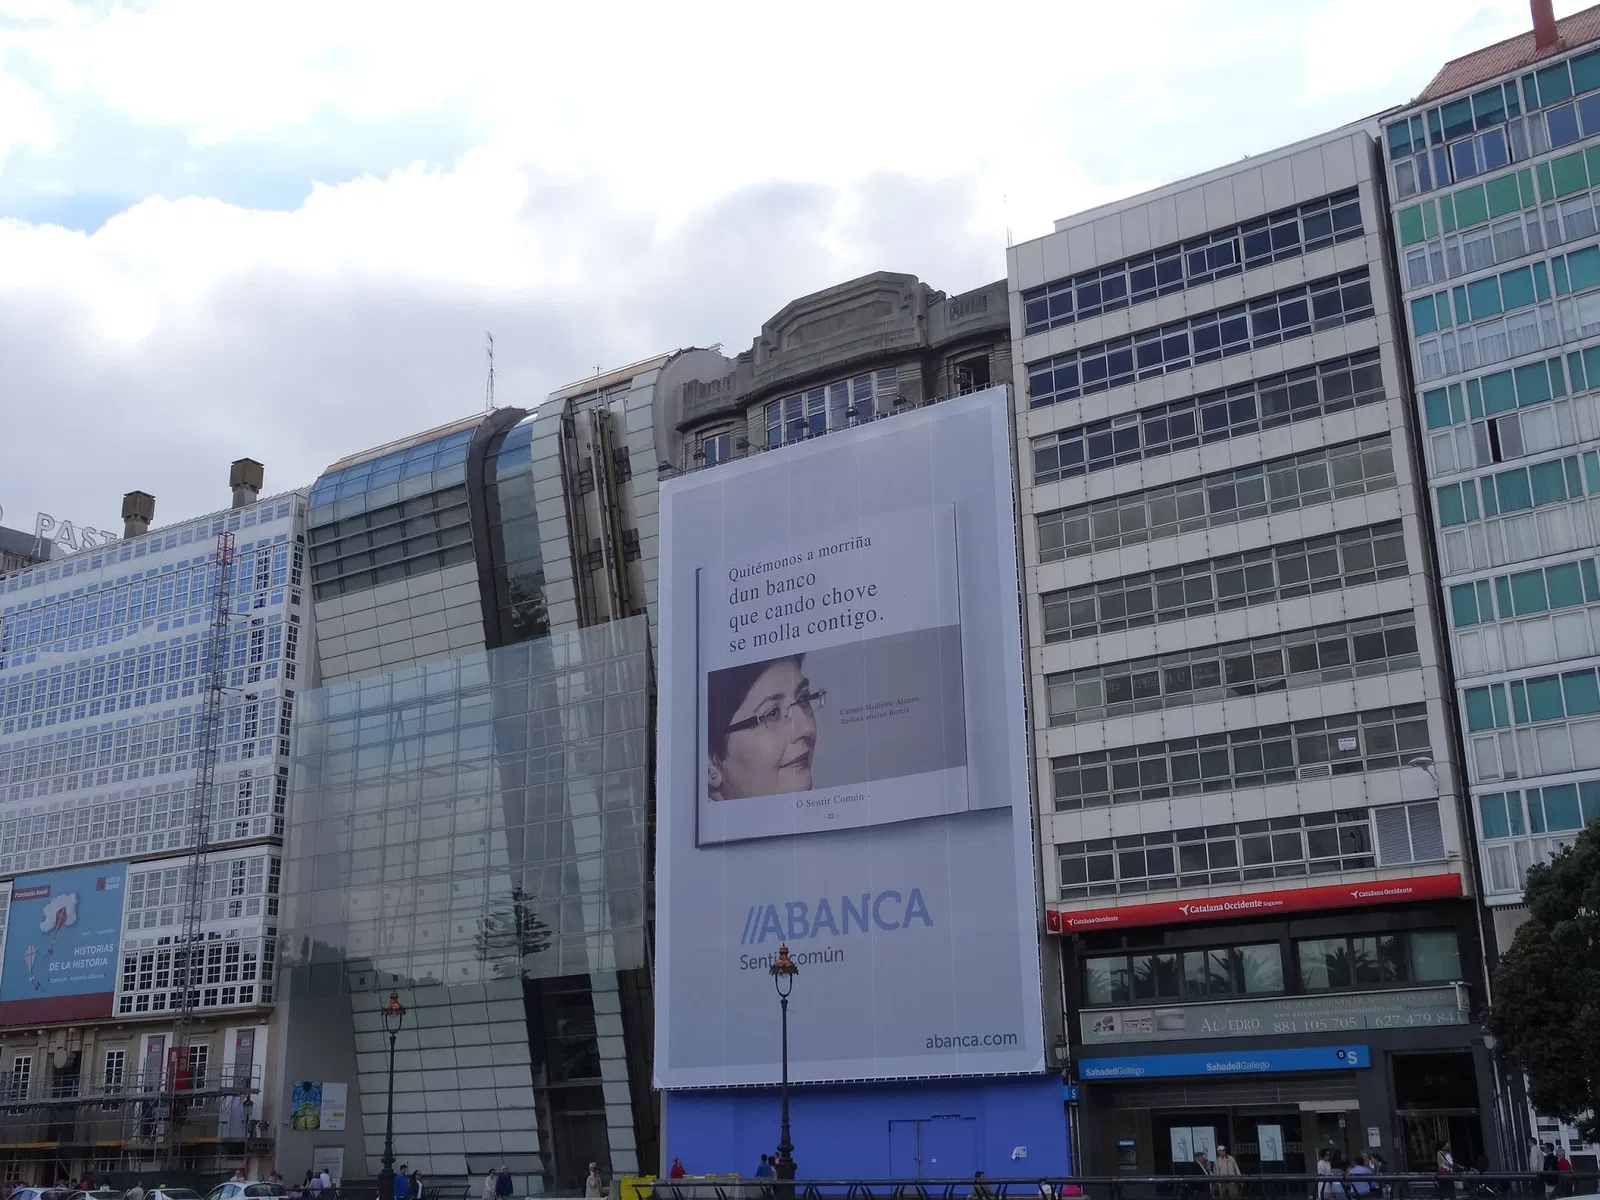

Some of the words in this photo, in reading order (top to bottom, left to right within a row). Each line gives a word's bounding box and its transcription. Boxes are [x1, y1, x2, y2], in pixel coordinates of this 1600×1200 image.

[728, 553, 802, 582] Quitémonos
[807, 551, 814, 561] a
[818, 536, 872, 558] morriña
[729, 588, 760, 605] dun
[766, 572, 816, 596] banco
[729, 610, 759, 633] que
[765, 595, 815, 620] cando
[822, 583, 878, 606] chove
[729, 637, 746, 653] se
[753, 623, 801, 647] molla
[807, 608, 884, 635] contigo.
[840, 706, 864, 716] Carmen
[896, 696, 919, 705] Alonso
[840, 716, 864, 725] Xestora
[865, 711, 887, 720] oficina
[796, 800, 803, 808] O
[806, 797, 831, 807] Sentir
[833, 792, 864, 803] Común
[1190, 903, 1224, 913] Catalana
[1224, 900, 1262, 910] Occidente
[74, 943, 114, 956] HISTORIAS
[740, 952, 779, 970] Senti
[789, 946, 844, 965] común
[49, 962, 60, 971] DE
[61, 961, 71, 970] LA
[72, 957, 108, 969] HISTORIA
[1274, 1020, 1296, 1033] 881
[1304, 1019, 1327, 1031] 105
[1332, 1017, 1357, 1029] 705
[1375, 1015, 1400, 1028] 627
[1405, 1012, 1431, 1025] 479
[1436, 1011, 1463, 1024] 841
[925, 1033, 1018, 1049] abanca.com
[1347, 1051, 1358, 1065] S
